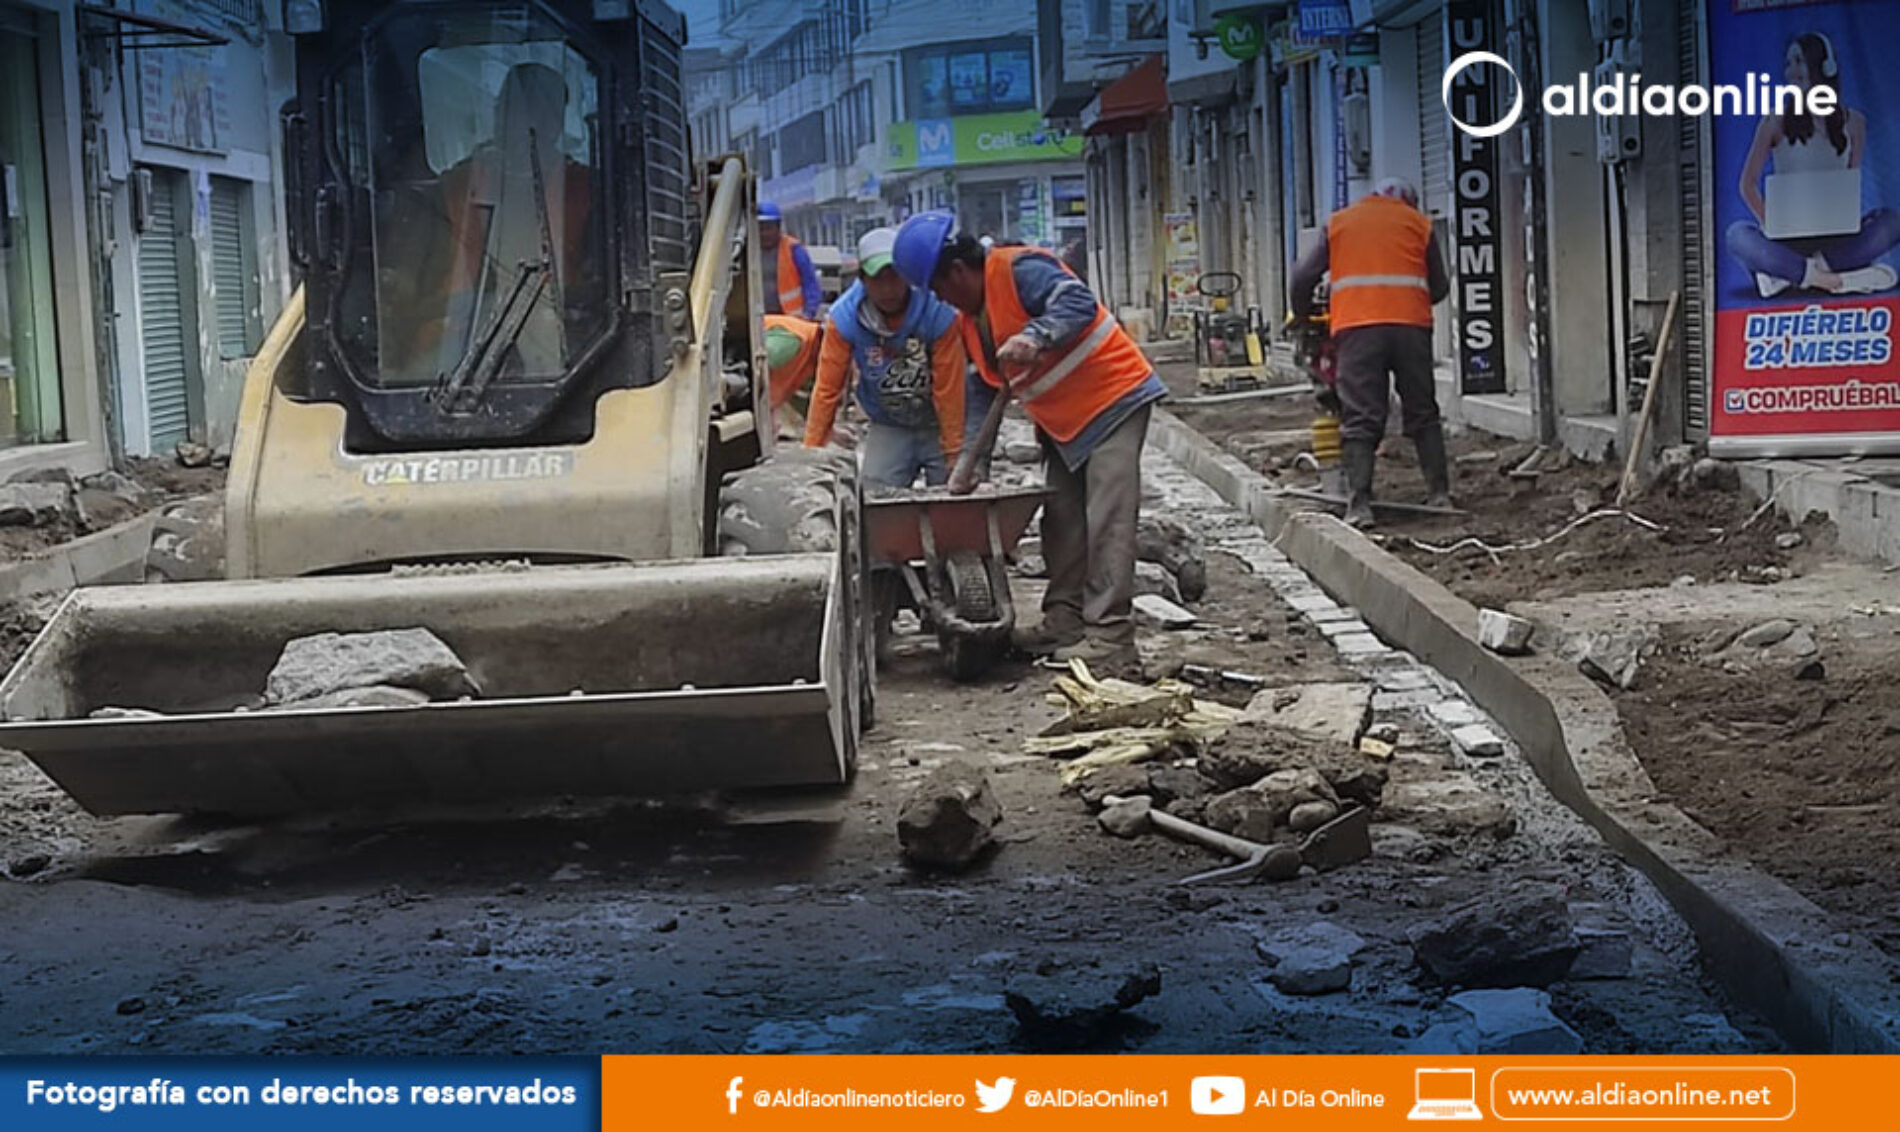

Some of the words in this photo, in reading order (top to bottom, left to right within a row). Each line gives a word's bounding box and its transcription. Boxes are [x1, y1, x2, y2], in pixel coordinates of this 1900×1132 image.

[1454, 17, 1494, 351] UNIFORMES
[1746, 306, 1890, 341] DIFIÉRELO
[1747, 342, 1785, 369] 24
[1790, 338, 1890, 366] MESES
[1746, 380, 1900, 411] COMPRUÉBAL
[365, 454, 564, 486] CATERPILLAR
